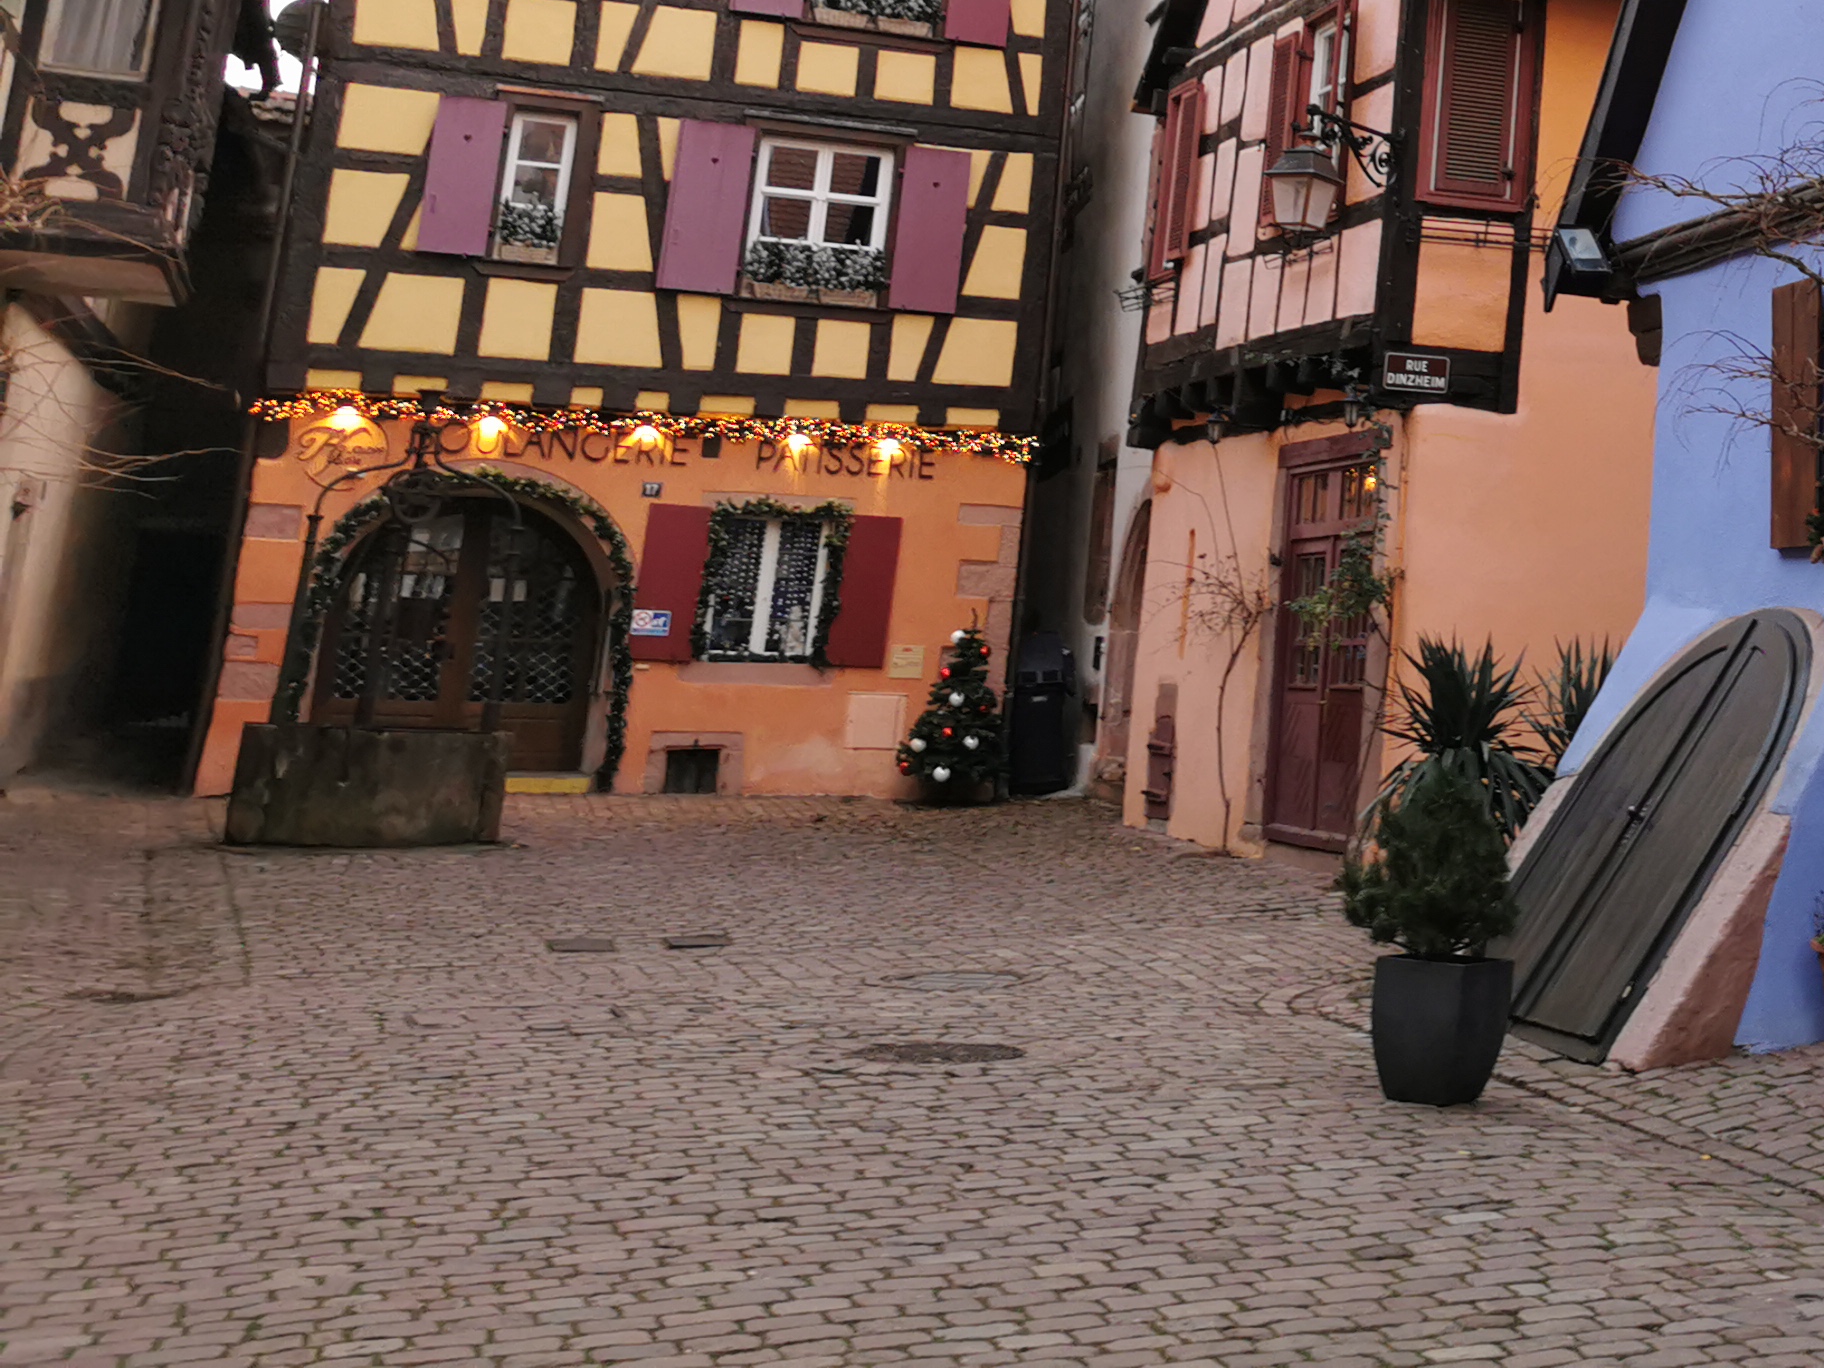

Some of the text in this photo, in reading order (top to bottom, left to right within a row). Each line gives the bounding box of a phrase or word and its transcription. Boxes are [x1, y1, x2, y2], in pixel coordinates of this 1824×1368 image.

[1406, 359, 1429, 372] RUE
[1387, 373, 1446, 388] DINZHEIM
[412, 421, 688, 468] OULANGERIE
[645, 483, 659, 496] 17
